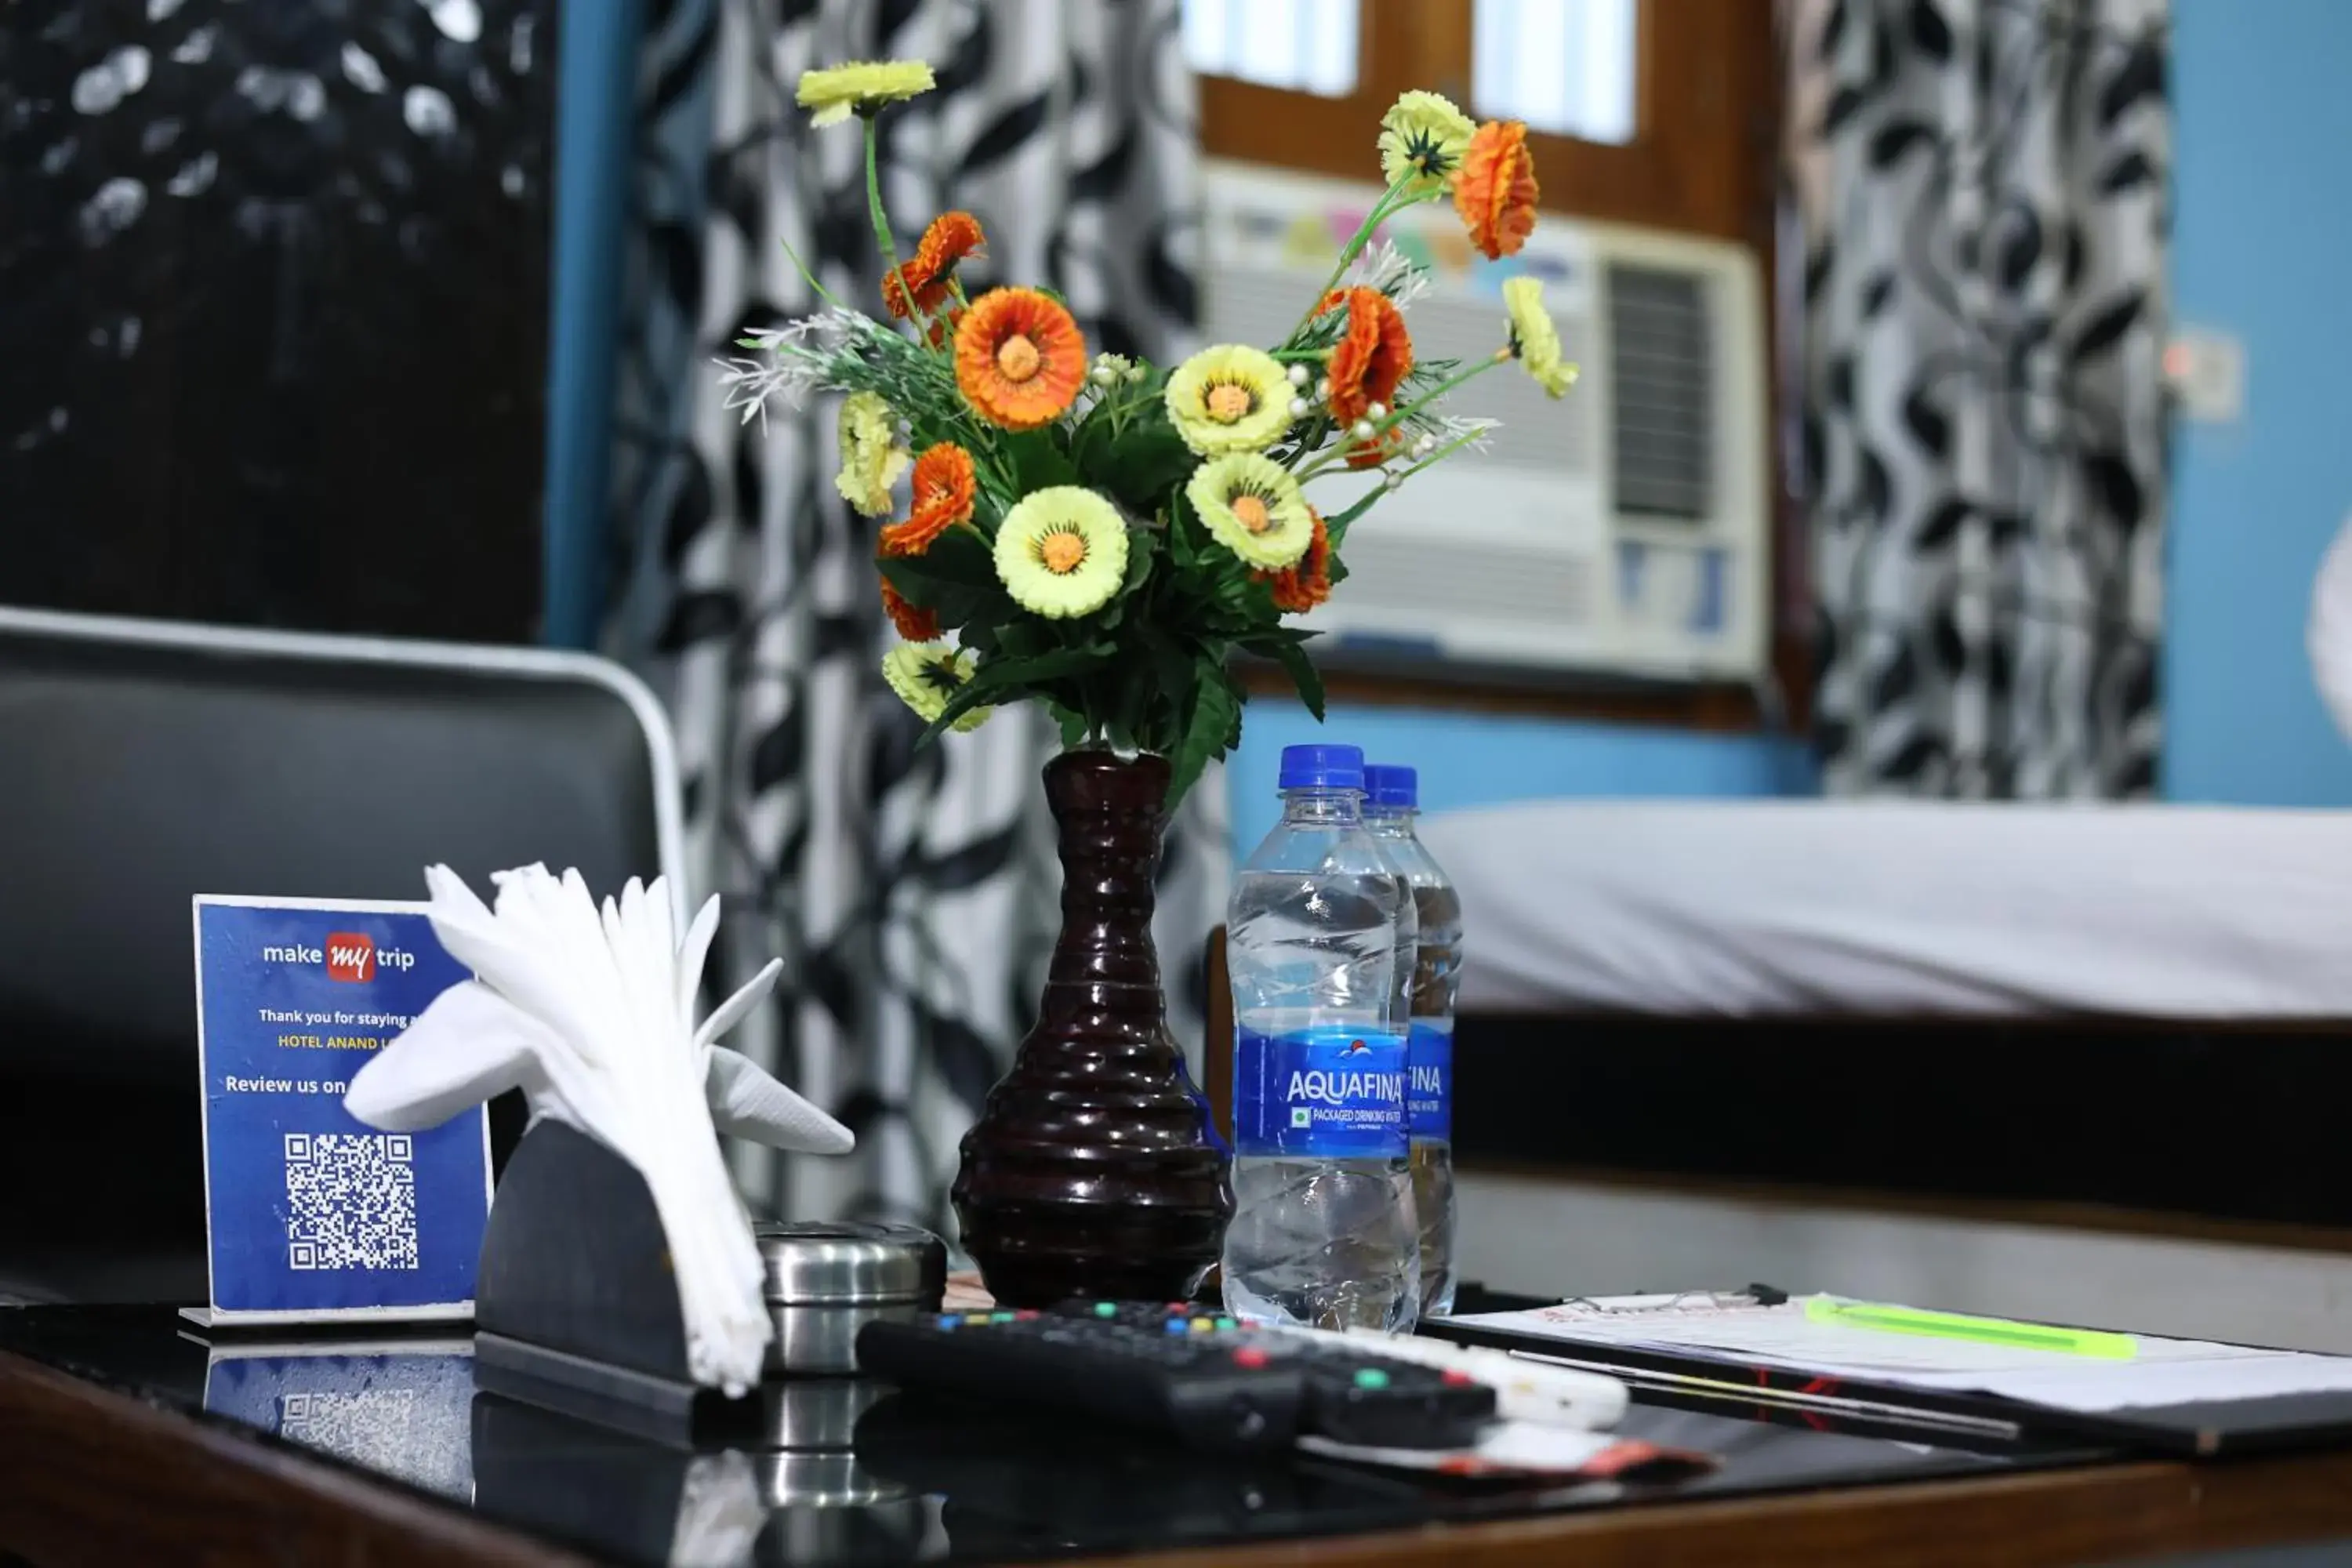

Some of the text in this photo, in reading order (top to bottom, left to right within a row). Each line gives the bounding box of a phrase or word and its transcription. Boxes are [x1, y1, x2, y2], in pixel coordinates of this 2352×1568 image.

[263, 943, 415, 979] make my trip
[259, 1009, 303, 1023] Thank
[306, 1014, 332, 1025] you
[334, 1011, 354, 1024] for
[358, 1013, 407, 1029] staying
[278, 1035, 323, 1048] HOTEL
[327, 1037, 378, 1050] ANAND
[226, 1075, 346, 1094] Review us on
[1287, 1070, 1403, 1105] AQUAFINA
[1313, 1108, 1354, 1122] PACKAGED
